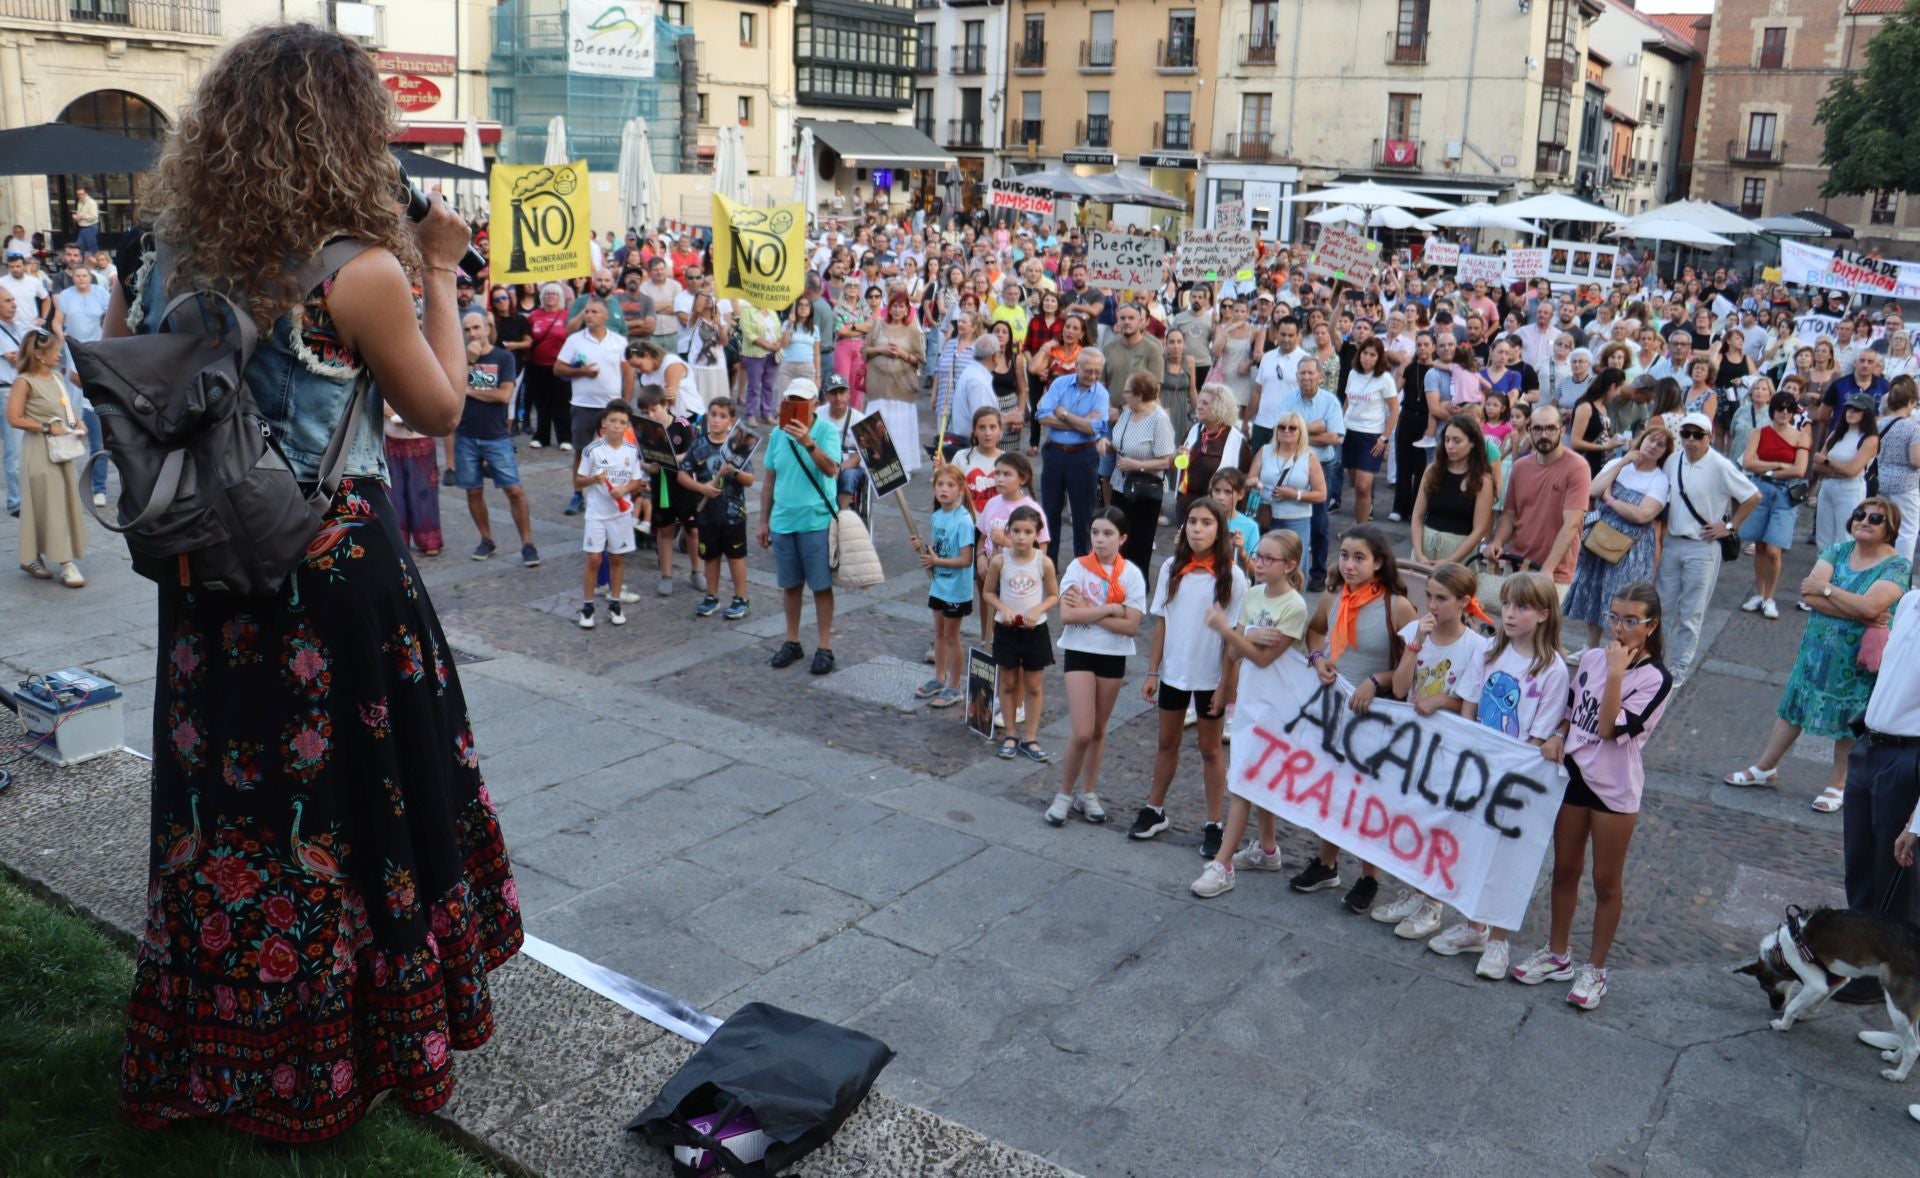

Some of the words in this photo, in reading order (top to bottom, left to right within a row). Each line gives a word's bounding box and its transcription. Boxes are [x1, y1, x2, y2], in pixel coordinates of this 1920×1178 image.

[397, 75, 421, 88] Bar
[994, 192, 1054, 213] DIMISIÓN
[508, 199, 567, 256] NO
[1093, 233, 1143, 252] Puente
[528, 252, 577, 264] INCINERADORA
[729, 227, 780, 284] NO
[1116, 253, 1162, 267] Castro
[1833, 247, 1899, 278] ALCALDE
[533, 264, 555, 273] PUENTE
[556, 261, 578, 271] CASTRO
[1832, 260, 1898, 291] DIMISIÓN
[765, 293, 790, 302] CASTRO
[1284, 685, 1547, 838] ALCALDE
